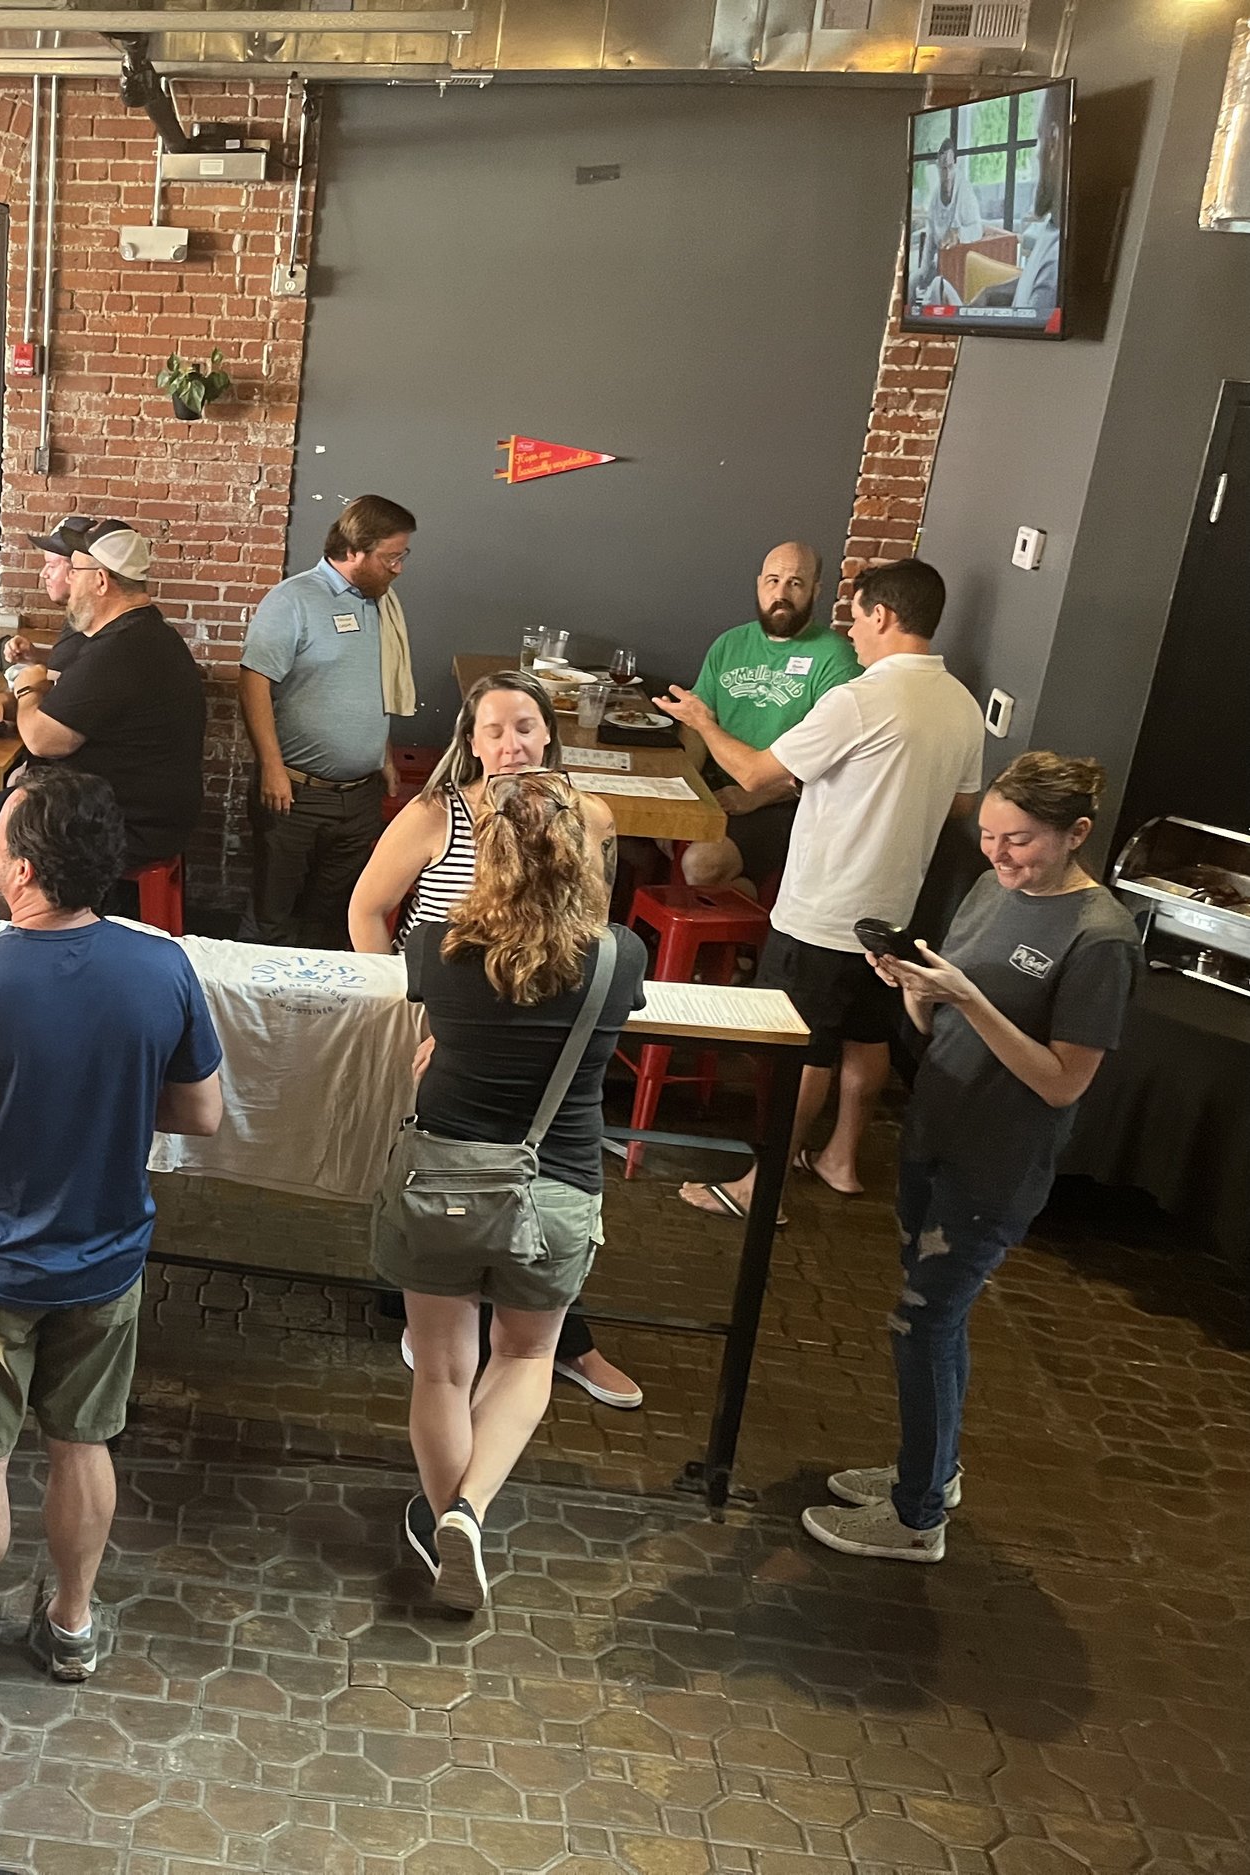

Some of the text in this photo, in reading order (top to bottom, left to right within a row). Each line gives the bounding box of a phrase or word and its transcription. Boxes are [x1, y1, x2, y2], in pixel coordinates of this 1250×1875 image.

[267, 984, 286, 999] THE
[316, 984, 349, 1006] NOBLE
[279, 1002, 334, 1016] HOPSTEINER
